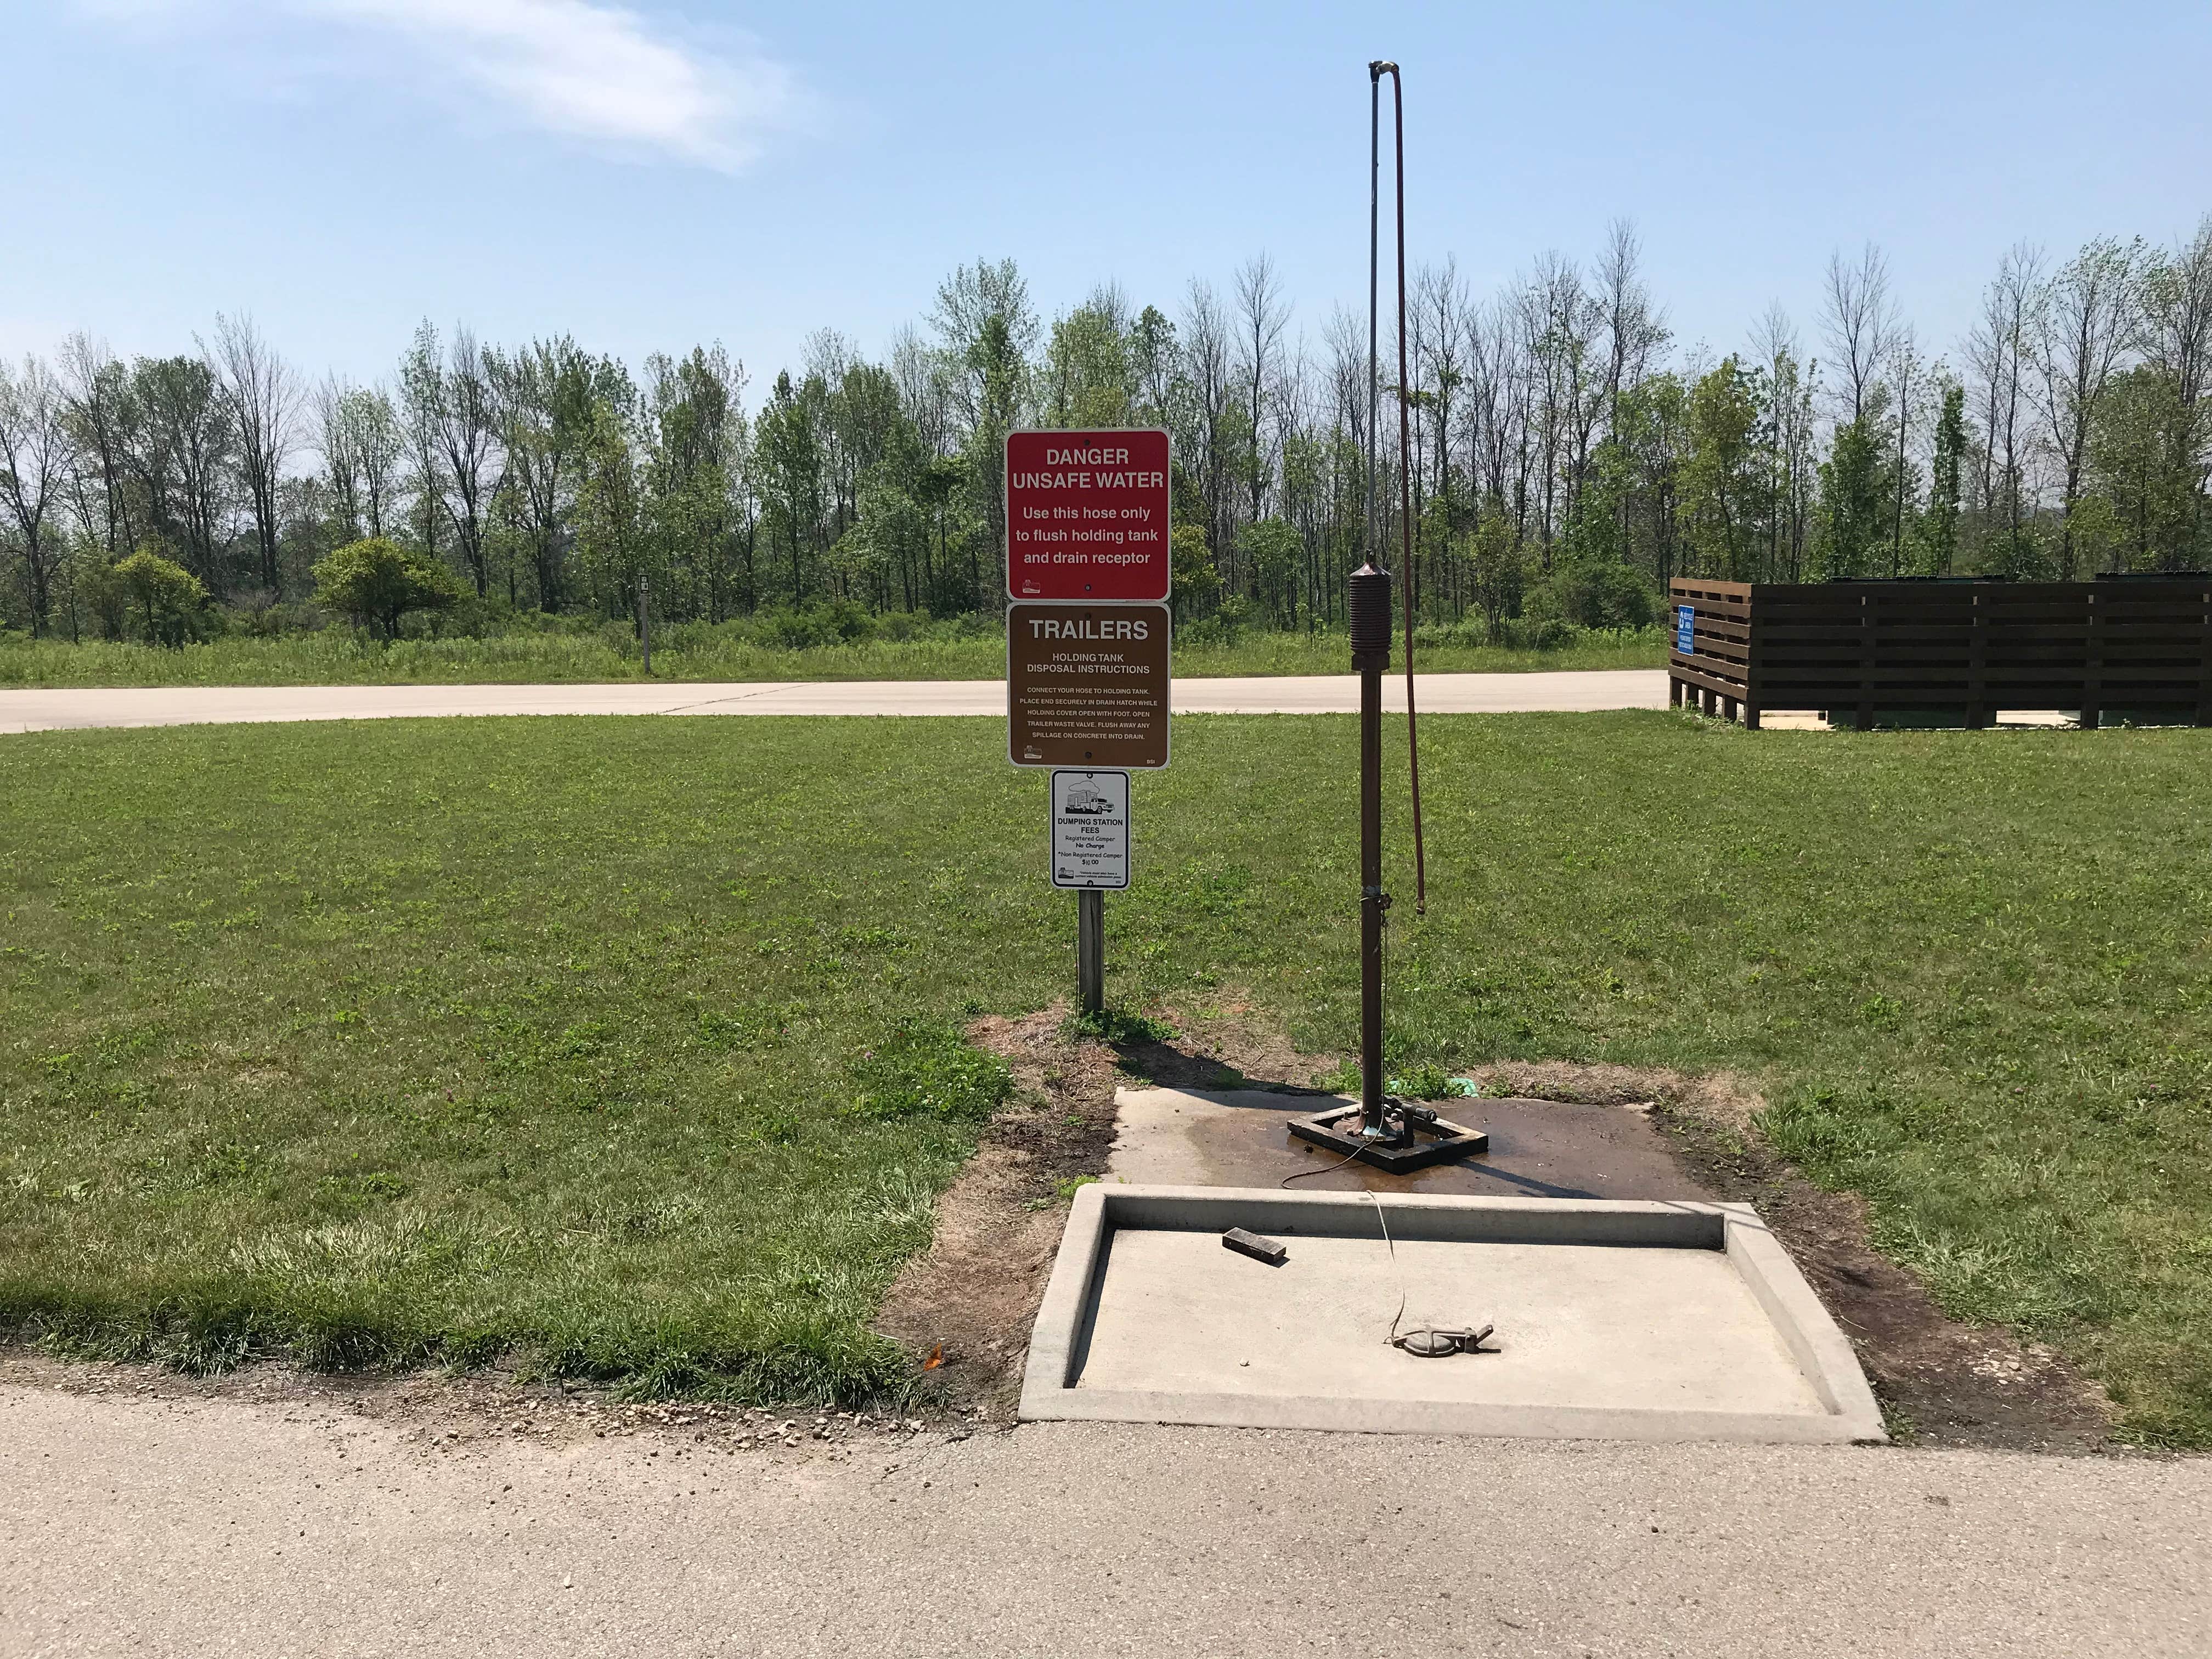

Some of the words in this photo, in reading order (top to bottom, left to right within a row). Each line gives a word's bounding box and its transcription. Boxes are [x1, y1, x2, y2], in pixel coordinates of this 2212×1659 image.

[1047, 449, 1128, 465] DANGER
[1013, 472, 1091, 489] UNSAFE
[1096, 472, 1164, 488] WATER
[1023, 507, 1049, 519] Use
[1053, 507, 1079, 519] this
[1083, 507, 1117, 519] hose
[1121, 506, 1151, 521] only
[1016, 530, 1030, 541] to
[1034, 529, 1068, 541] flush
[1072, 529, 1124, 544] holding
[1128, 529, 1158, 541] tank
[1024, 551, 1049, 564] and
[1053, 551, 1088, 564] drain
[1092, 552, 1150, 567] receptor
[1029, 619, 1148, 640] TRAILERS
[1053, 653, 1096, 662] HOLDING
[1098, 653, 1124, 662] TANK
[1027, 664, 1075, 673] DISPOSAL
[1078, 665, 1150, 674] INSTRUCTIONS
